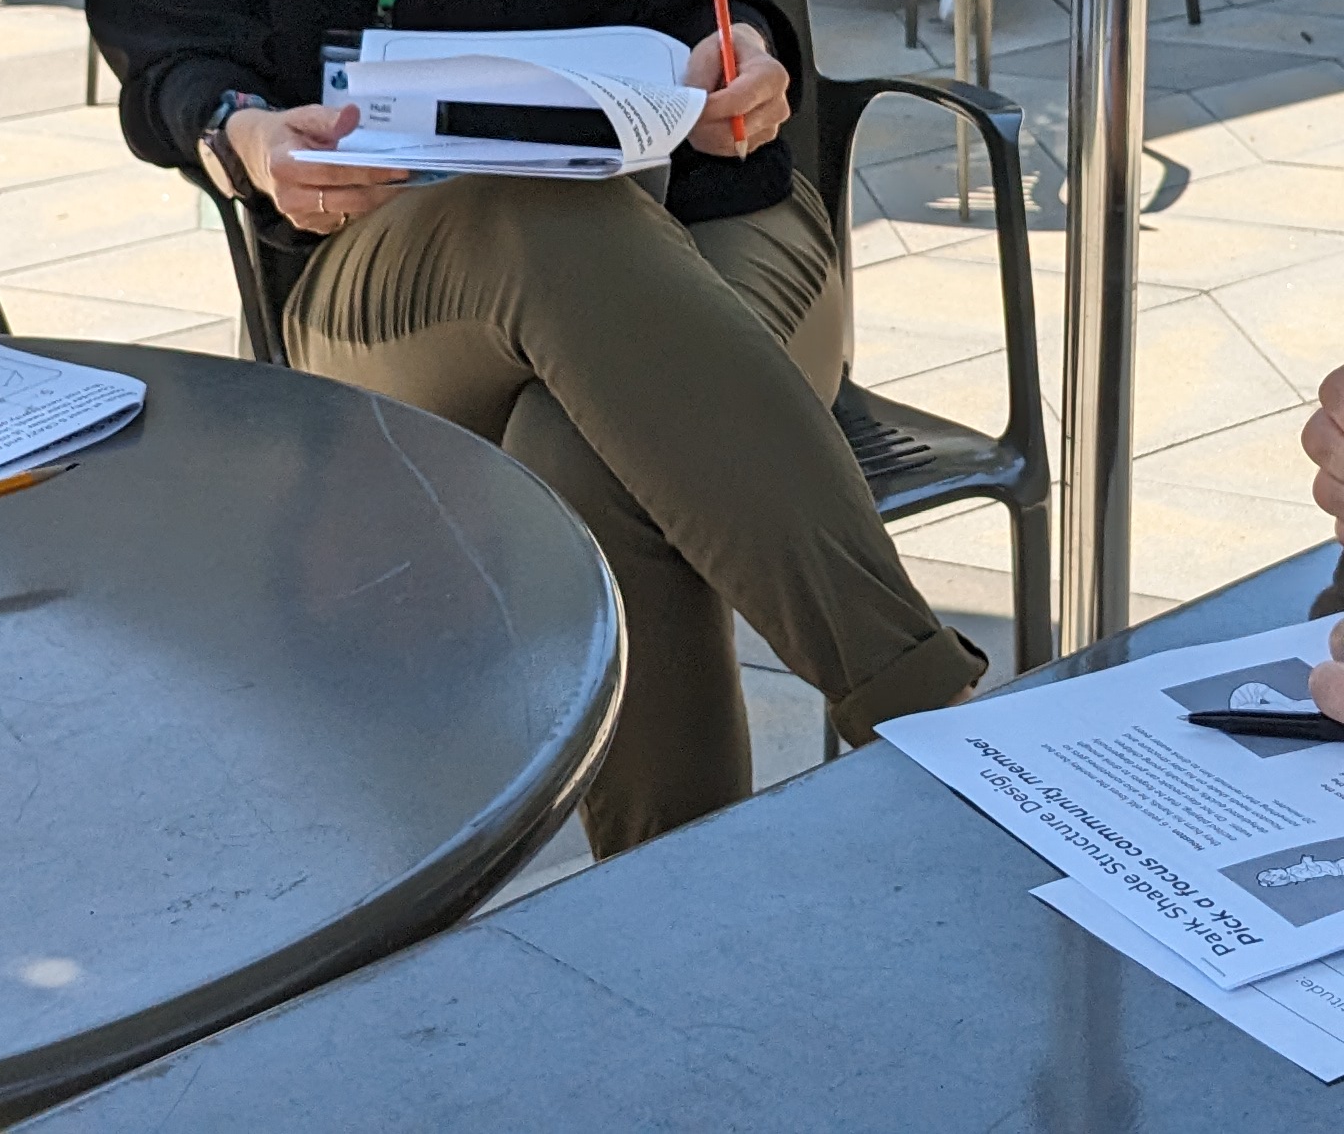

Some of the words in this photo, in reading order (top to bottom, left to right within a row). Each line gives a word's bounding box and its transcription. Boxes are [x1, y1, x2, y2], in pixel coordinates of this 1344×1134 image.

[1121, 732, 1139, 742] and
[1131, 725, 1152, 738] every
[1053, 751, 1070, 762] bars
[1070, 749, 1089, 759] gets
[1076, 741, 1104, 757] enough
[1092, 738, 1134, 764] dangerously
[1137, 742, 1170, 762] structure
[965, 738, 1042, 784] member
[1070, 761, 1097, 779] monkey
[1085, 759, 1125, 783] sometimes
[1140, 757, 1166, 771] young
[1095, 779, 1110, 788] the
[1145, 771, 1160, 779] can
[1164, 770, 1199, 791] especially
[980, 769, 1042, 813] Design
[1206, 784, 1230, 797] shade
[1320, 783, 1335, 792] the
[1228, 797, 1251, 811] needs
[1036, 787, 1141, 856] community
[1140, 808, 1163, 822] years
[1223, 807, 1268, 833] dehydrated
[1250, 810, 1284, 830] Houston
[1259, 803, 1300, 826] something
[1183, 822, 1203, 834] burn
[1040, 813, 1125, 874] Structure
[1171, 828, 1204, 851] Houston
[1139, 858, 1198, 896] focus
[1123, 874, 1186, 918] Shade
[1193, 897, 1214, 907] a
[1183, 917, 1235, 956] Park
[1210, 910, 1263, 944] Pick
